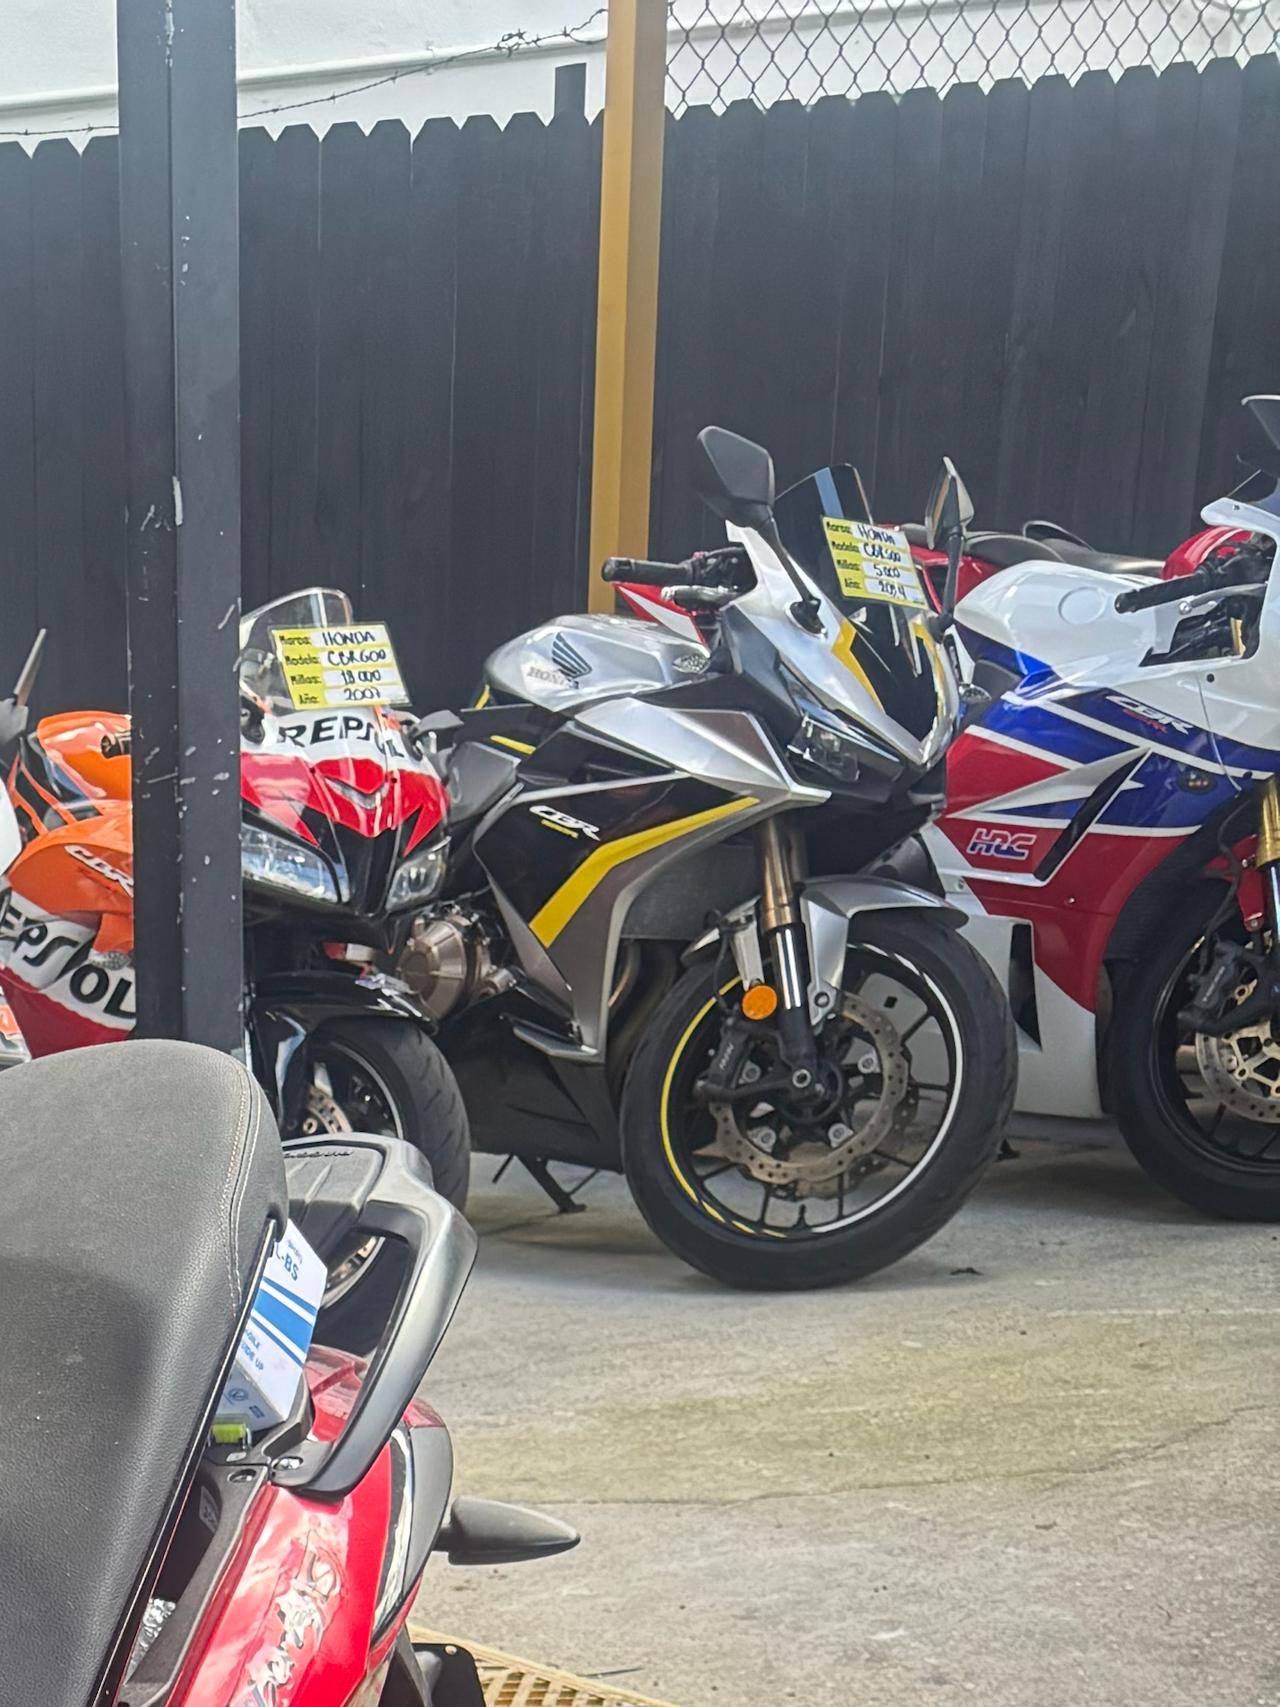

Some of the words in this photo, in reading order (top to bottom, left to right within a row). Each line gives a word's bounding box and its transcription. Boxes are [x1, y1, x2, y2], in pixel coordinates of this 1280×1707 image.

[322, 631, 376, 646] HONDA
[343, 687, 381, 701] 2007
[1105, 695, 1194, 735] CBR
[529, 805, 601, 841] CBR
[966, 828, 1038, 861] HRC
[64, 845, 135, 899] CBR
